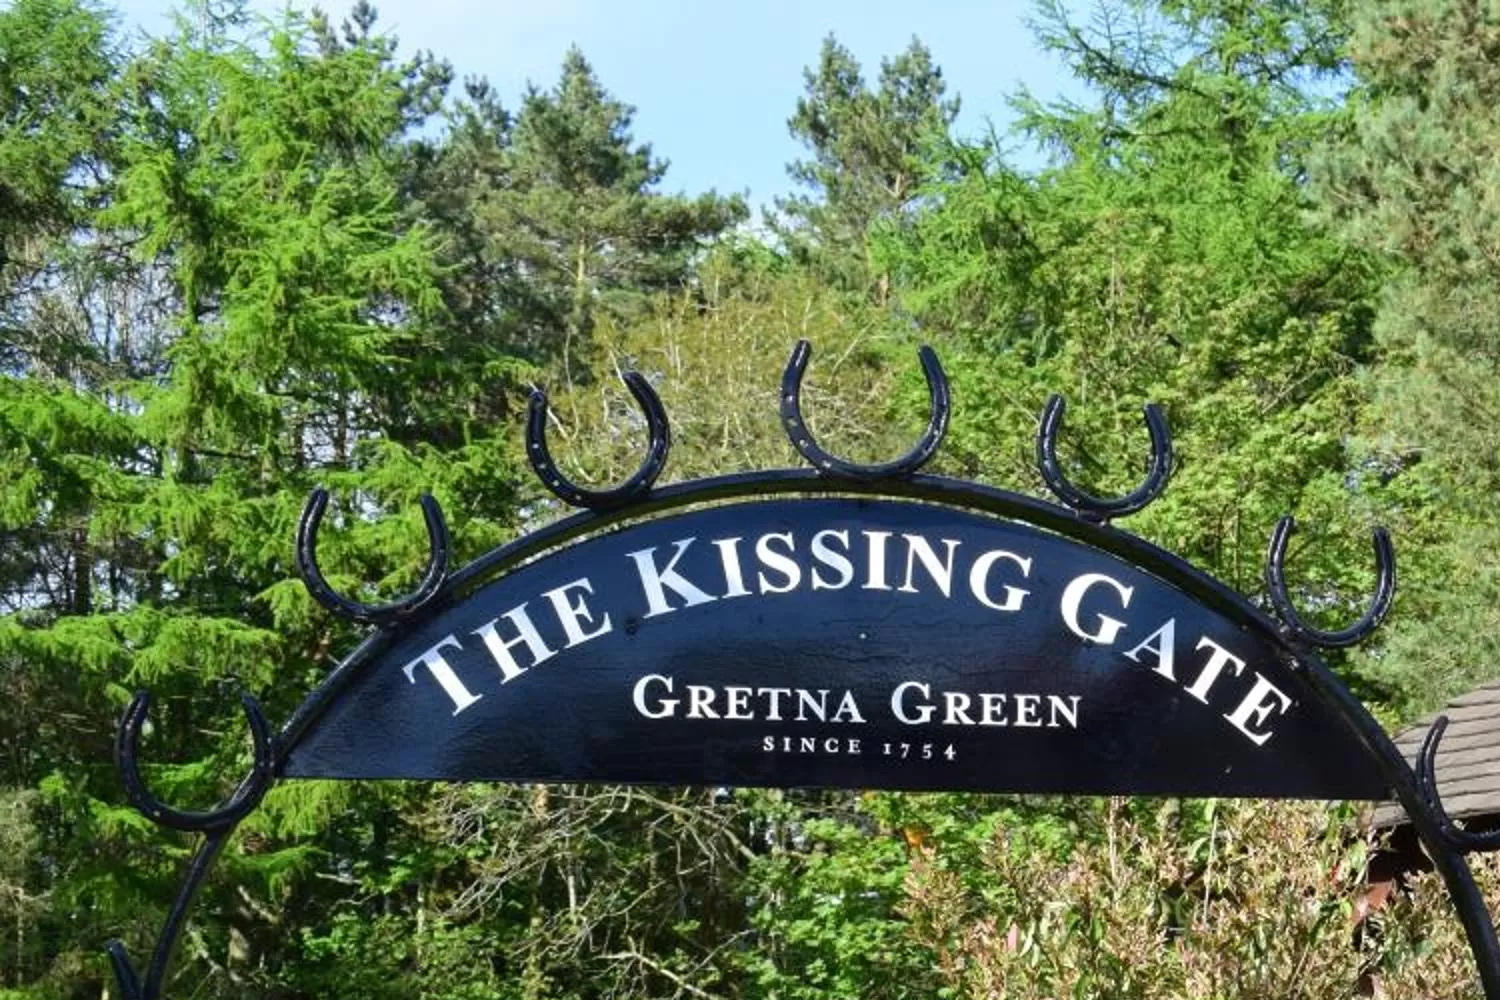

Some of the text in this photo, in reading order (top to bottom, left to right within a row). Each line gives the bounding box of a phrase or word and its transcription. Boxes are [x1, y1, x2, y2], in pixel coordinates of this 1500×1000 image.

[401, 529, 1293, 747] THE KISSING GATE
[632, 673, 1083, 729] GRETNA GREEN
[762, 735, 958, 761] SINCE 1754
